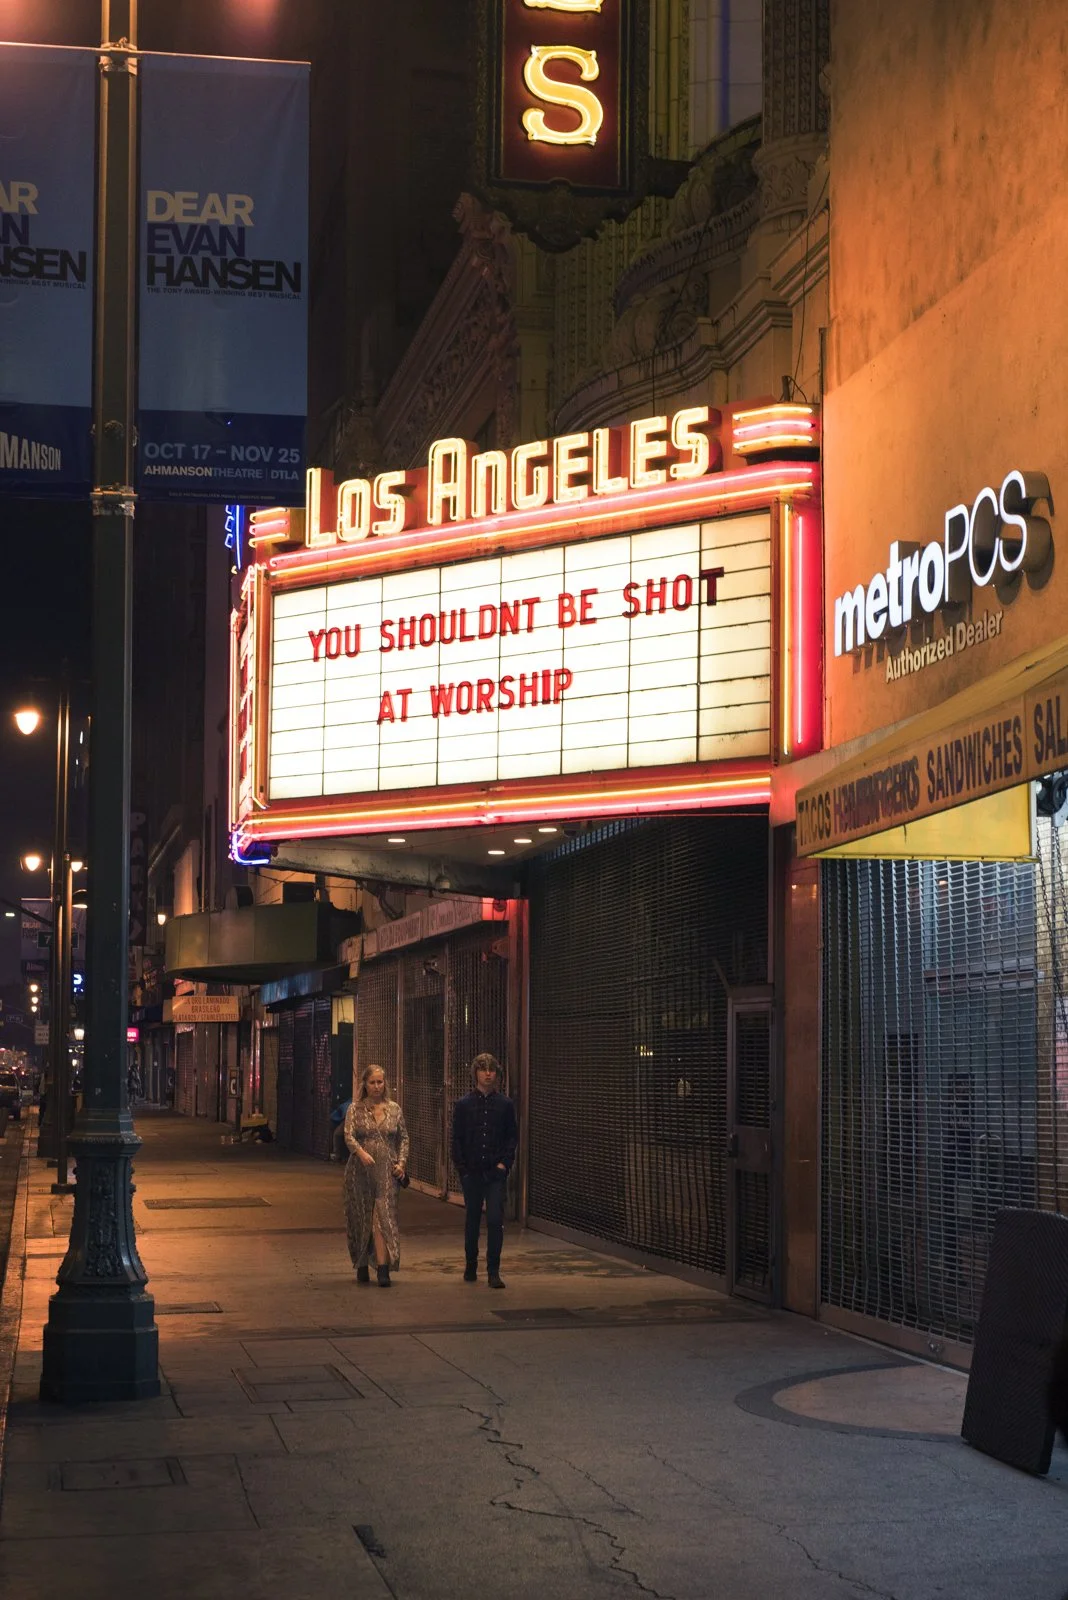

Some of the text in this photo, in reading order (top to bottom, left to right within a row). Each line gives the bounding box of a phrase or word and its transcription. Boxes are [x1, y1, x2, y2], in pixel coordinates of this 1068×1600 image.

[147, 190, 255, 226] DEAR
[147, 224, 245, 257] EVAN
[147, 256, 301, 293] HANSEN
[163, 287, 183, 295] TONY
[247, 290, 267, 298] BEST
[268, 292, 302, 300] MUSICAL
[144, 442, 186, 460] OCT
[192, 444, 211, 460] 17
[231, 445, 274, 462] NOV
[278, 448, 300, 463] 25
[271, 469, 299, 480] DTLA
[834, 469, 1028, 657] metroPCS
[308, 567, 724, 662] YOU SHOULDNT BE SHOT
[885, 610, 1004, 684] Authorized Dealer
[378, 668, 572, 723] AT WORSHIP
[798, 791, 830, 846] TACOS
[926, 715, 1023, 804] SANDWICHES
[1034, 696, 1068, 765] SAL
